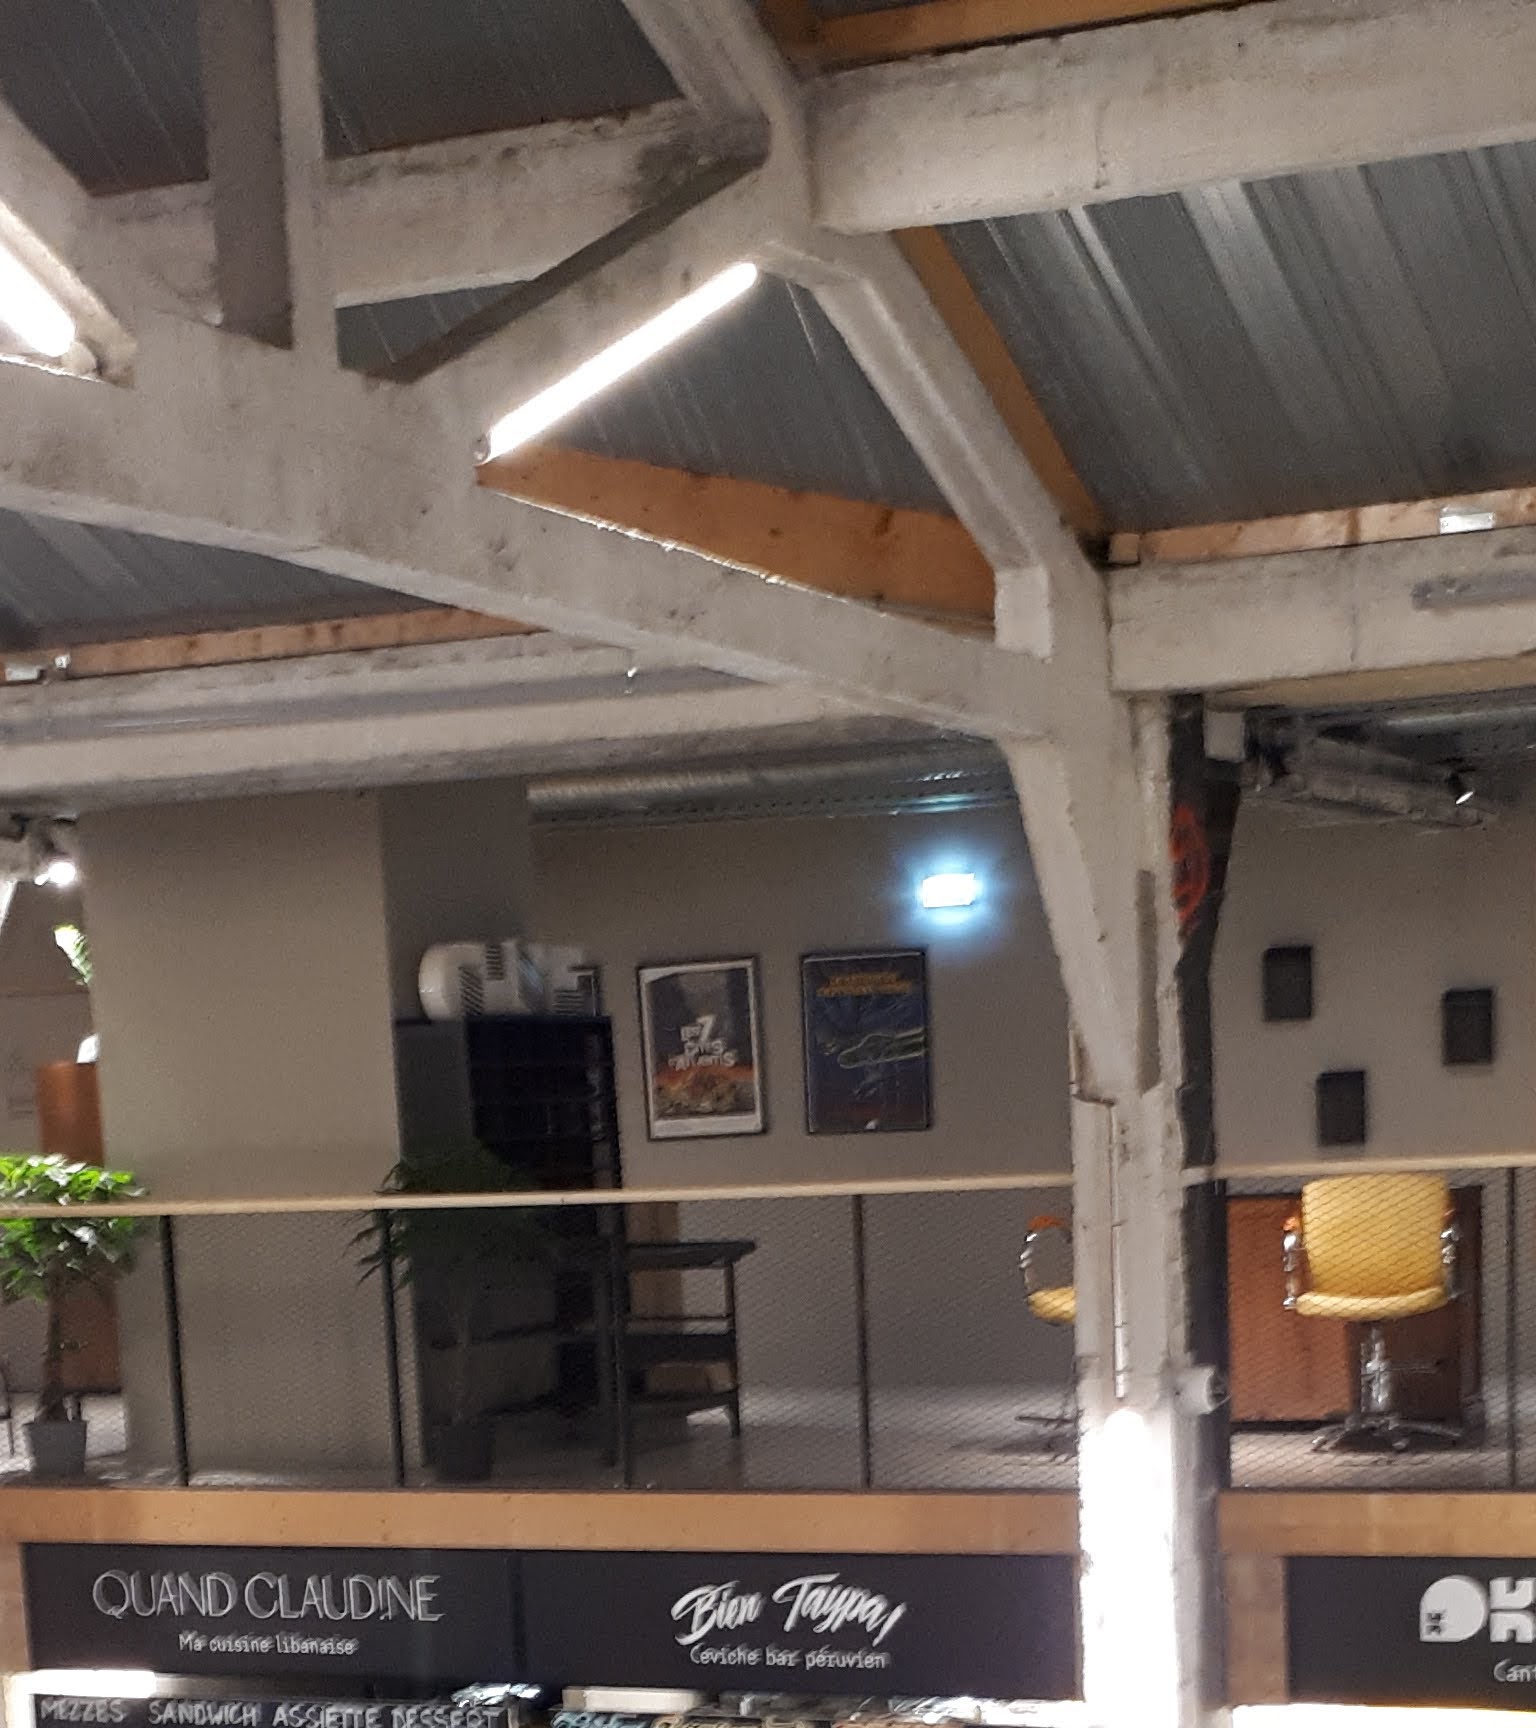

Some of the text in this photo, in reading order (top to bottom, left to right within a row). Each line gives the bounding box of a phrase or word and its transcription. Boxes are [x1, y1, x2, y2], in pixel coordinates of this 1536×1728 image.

[92, 1572, 237, 1619] QUAND
[671, 1580, 762, 1646] Bien
[178, 1633, 358, 1656] Ma cuisine libanaise
[690, 1644, 888, 1670] Ceviche bar péruvien
[41, 1700, 126, 1723] MEZZES
[149, 1702, 260, 1728] SANDWICH
